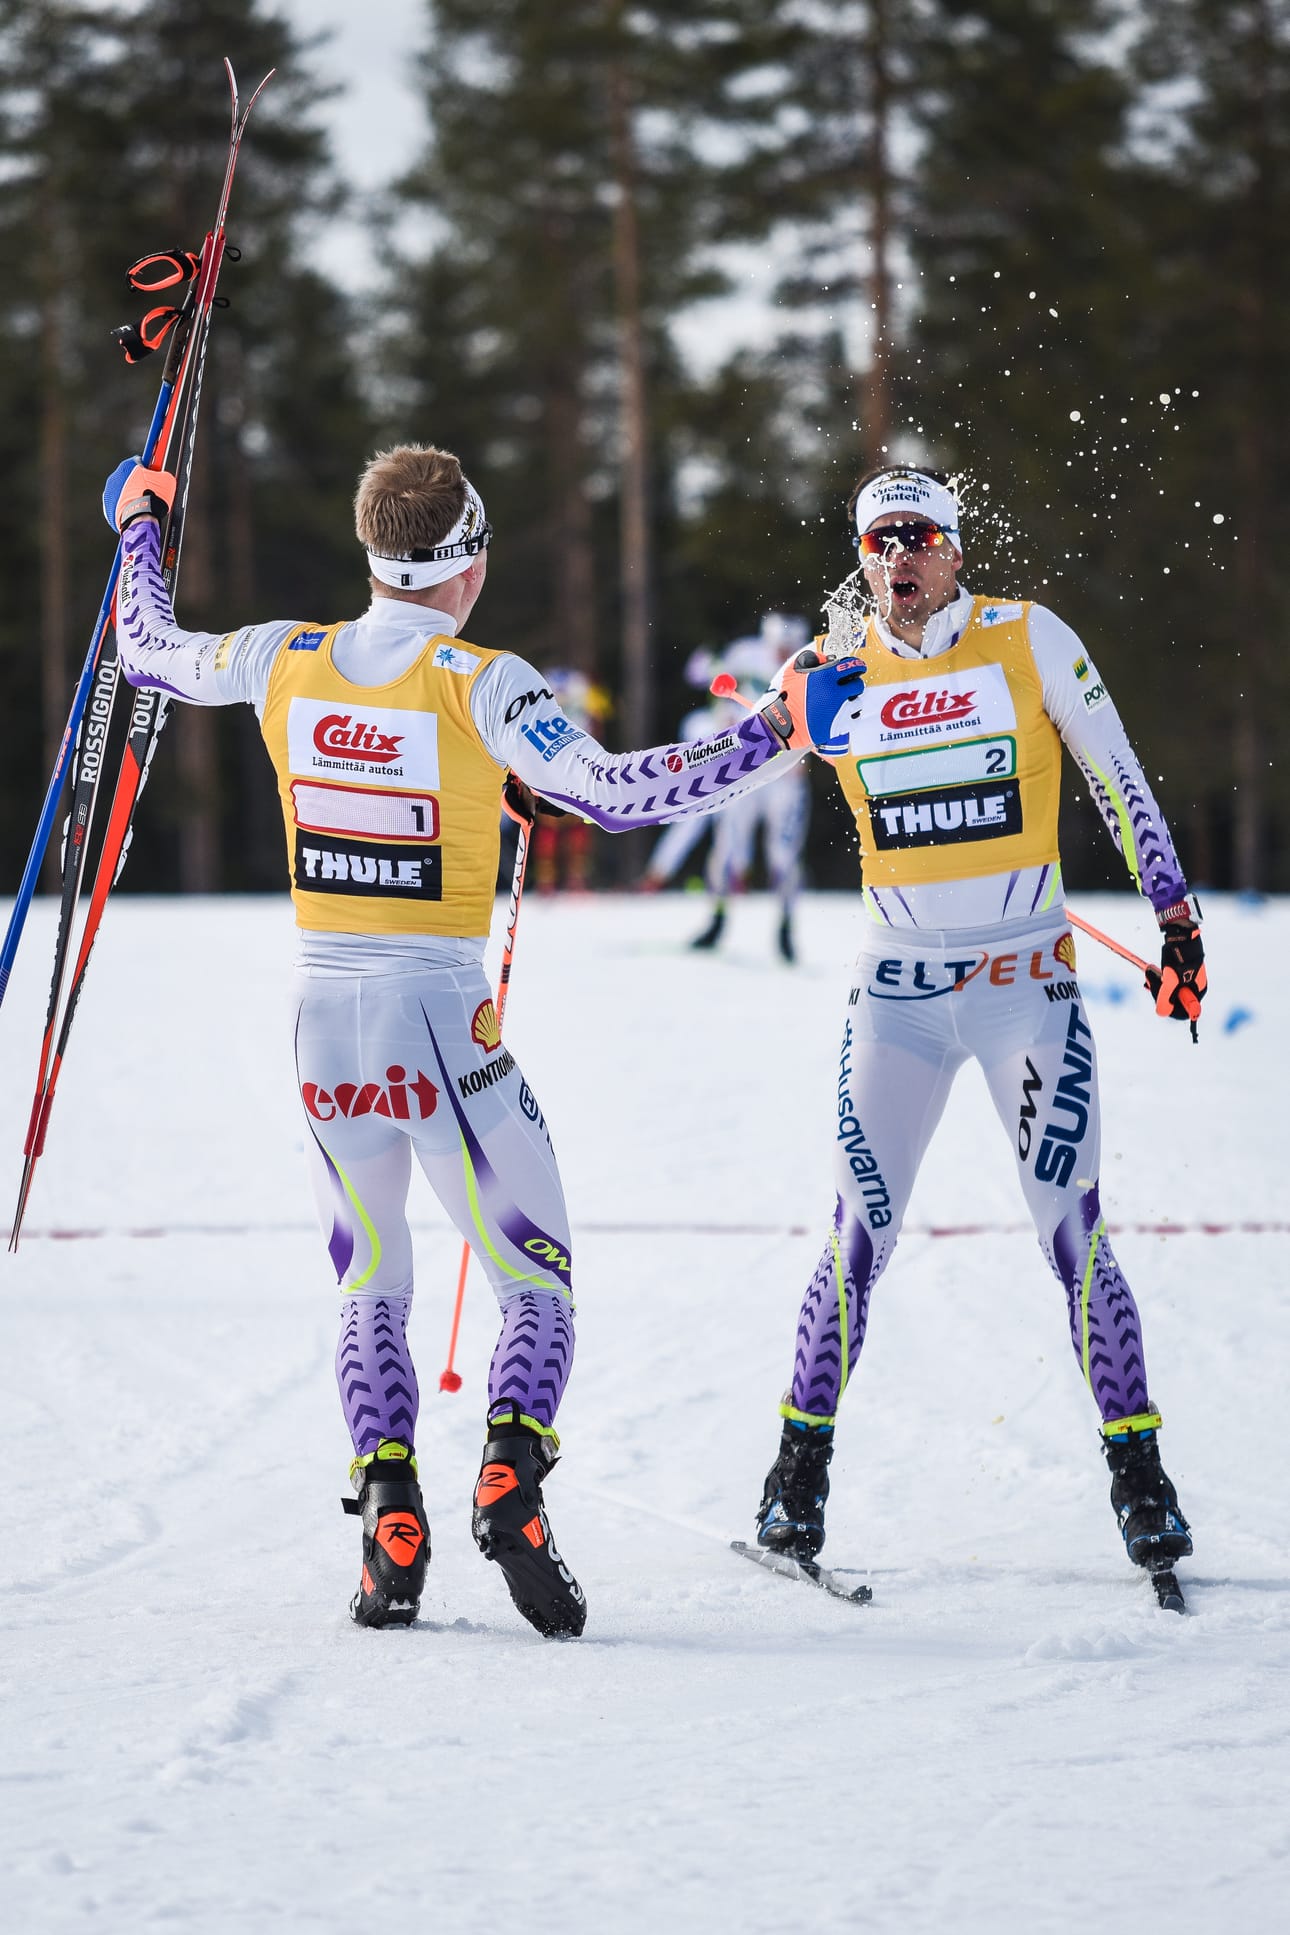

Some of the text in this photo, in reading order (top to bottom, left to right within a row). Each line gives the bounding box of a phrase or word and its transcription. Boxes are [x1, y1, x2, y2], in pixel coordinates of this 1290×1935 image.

[80, 655, 118, 784] ROSSIGNOL
[879, 716, 982, 743] Lämmittää autosi
[880, 690, 978, 730] Calix
[313, 714, 406, 764] Calix
[683, 735, 735, 764] Vuokatti
[312, 757, 405, 777] Lämmittää autosi
[985, 748, 1007, 775] 2
[410, 805, 425, 833] 1
[880, 794, 1007, 836] THULE
[971, 815, 1003, 825] SWEDEN
[302, 848, 422, 888] THULE
[384, 878, 417, 887] SWEDEN
[870, 950, 1054, 996] ELTEL
[302, 1065, 440, 1121] emit
[1034, 1003, 1092, 1189] SUNIT
[837, 1052, 893, 1231] Husqvarna
